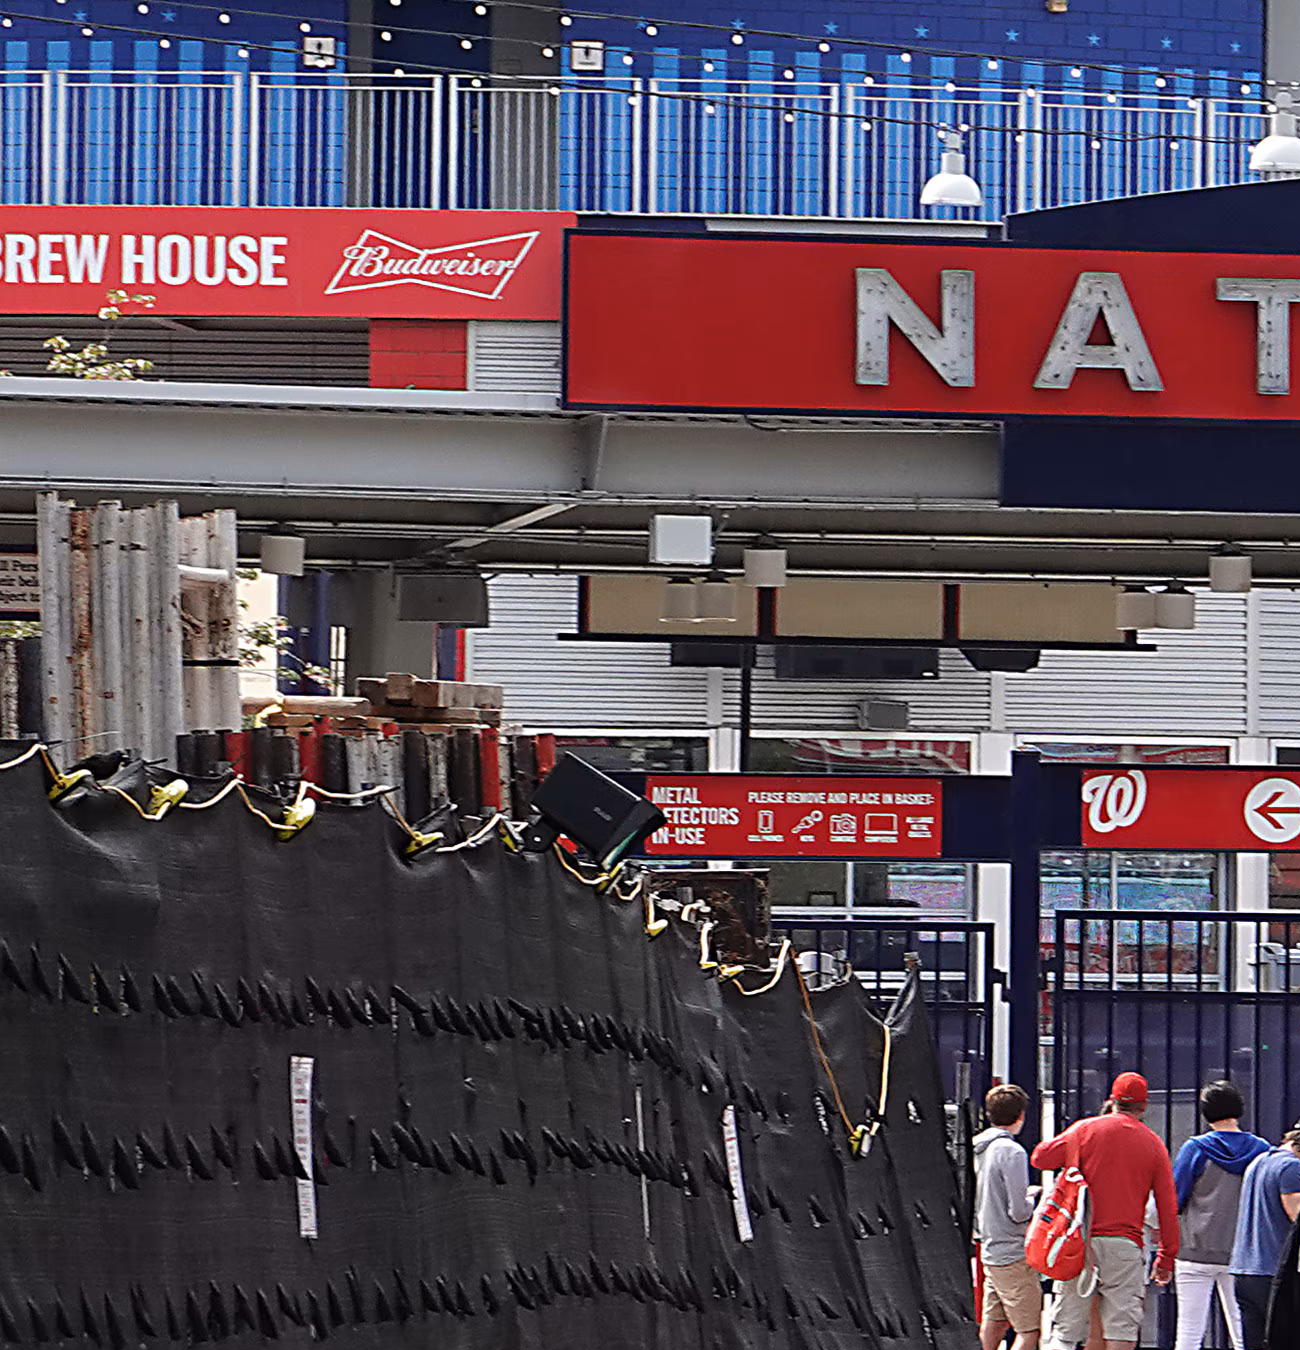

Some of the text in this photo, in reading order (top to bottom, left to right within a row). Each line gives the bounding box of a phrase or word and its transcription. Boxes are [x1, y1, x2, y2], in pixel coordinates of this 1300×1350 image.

[0, 233, 288, 286] REW HOUSE
[343, 244, 519, 278] Budweiser
[652, 786, 702, 805] METAL
[748, 791, 785, 804] PLEASE
[786, 792, 826, 804] REMOVE
[827, 792, 847, 804] AND
[849, 792, 880, 805] PLACE
[882, 793, 893, 805] IN
[659, 807, 740, 825] ETECTORS
